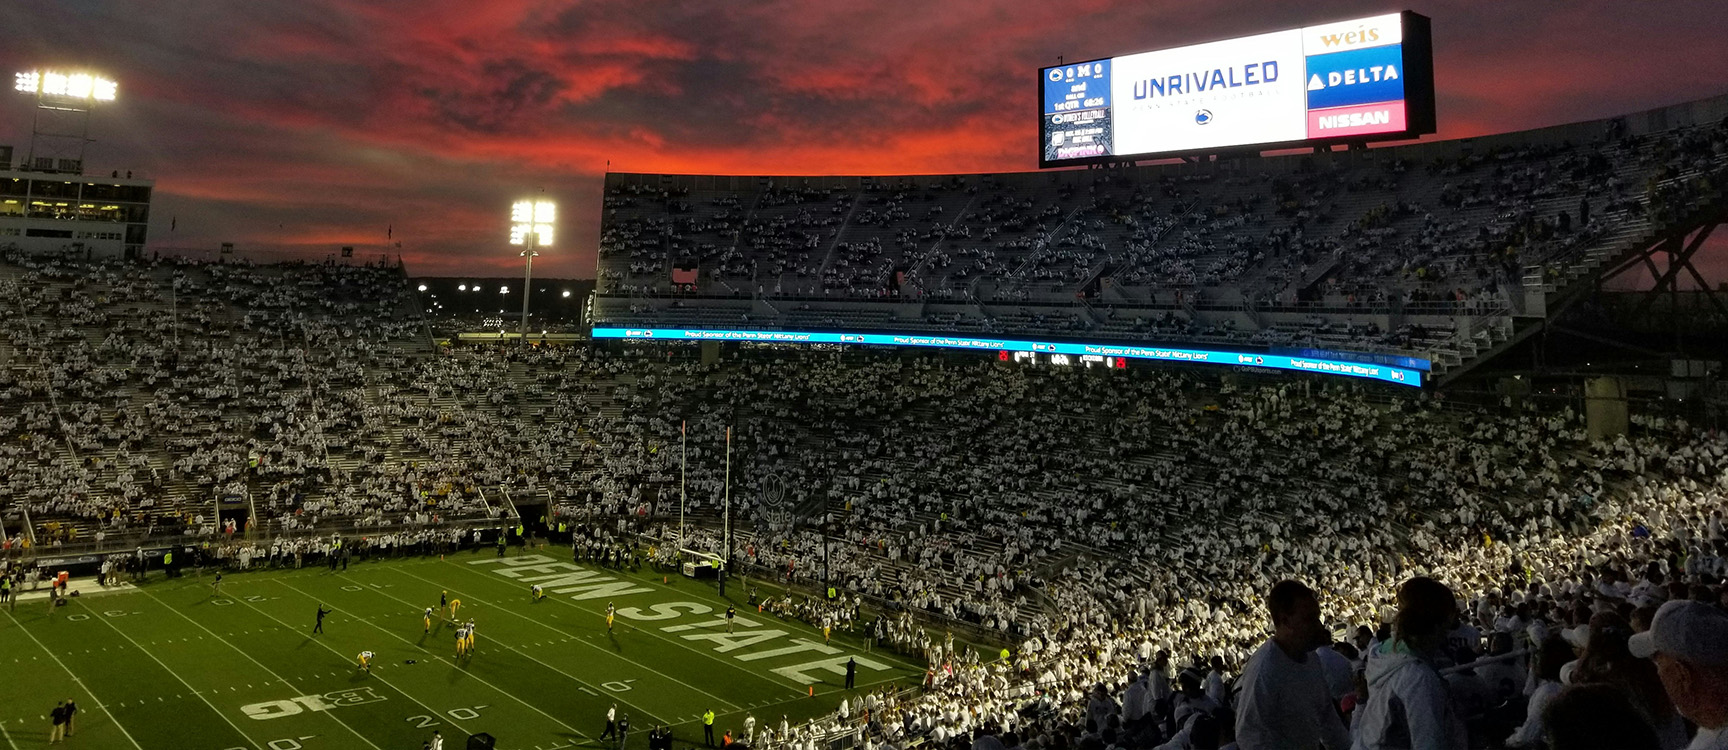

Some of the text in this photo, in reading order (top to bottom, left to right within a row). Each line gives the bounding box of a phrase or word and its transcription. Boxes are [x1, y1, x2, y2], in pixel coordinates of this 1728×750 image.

[1320, 24, 1379, 47] weis
[1077, 64, 1091, 77] M
[1134, 60, 1279, 100] UNRIVALED
[1328, 64, 1399, 87] DELTA
[1319, 110, 1390, 130] NISSAN
[702, 330, 724, 338] Sponsor
[773, 333, 794, 341] Nittany
[910, 337, 929, 345] Sponsor
[971, 340, 989, 348] Nittany
[1101, 346, 1123, 355] Sponsor
[1171, 351, 1192, 360] Nittany
[757, 503, 792, 524] Allstate
[466, 554, 894, 686] PENN STATE
